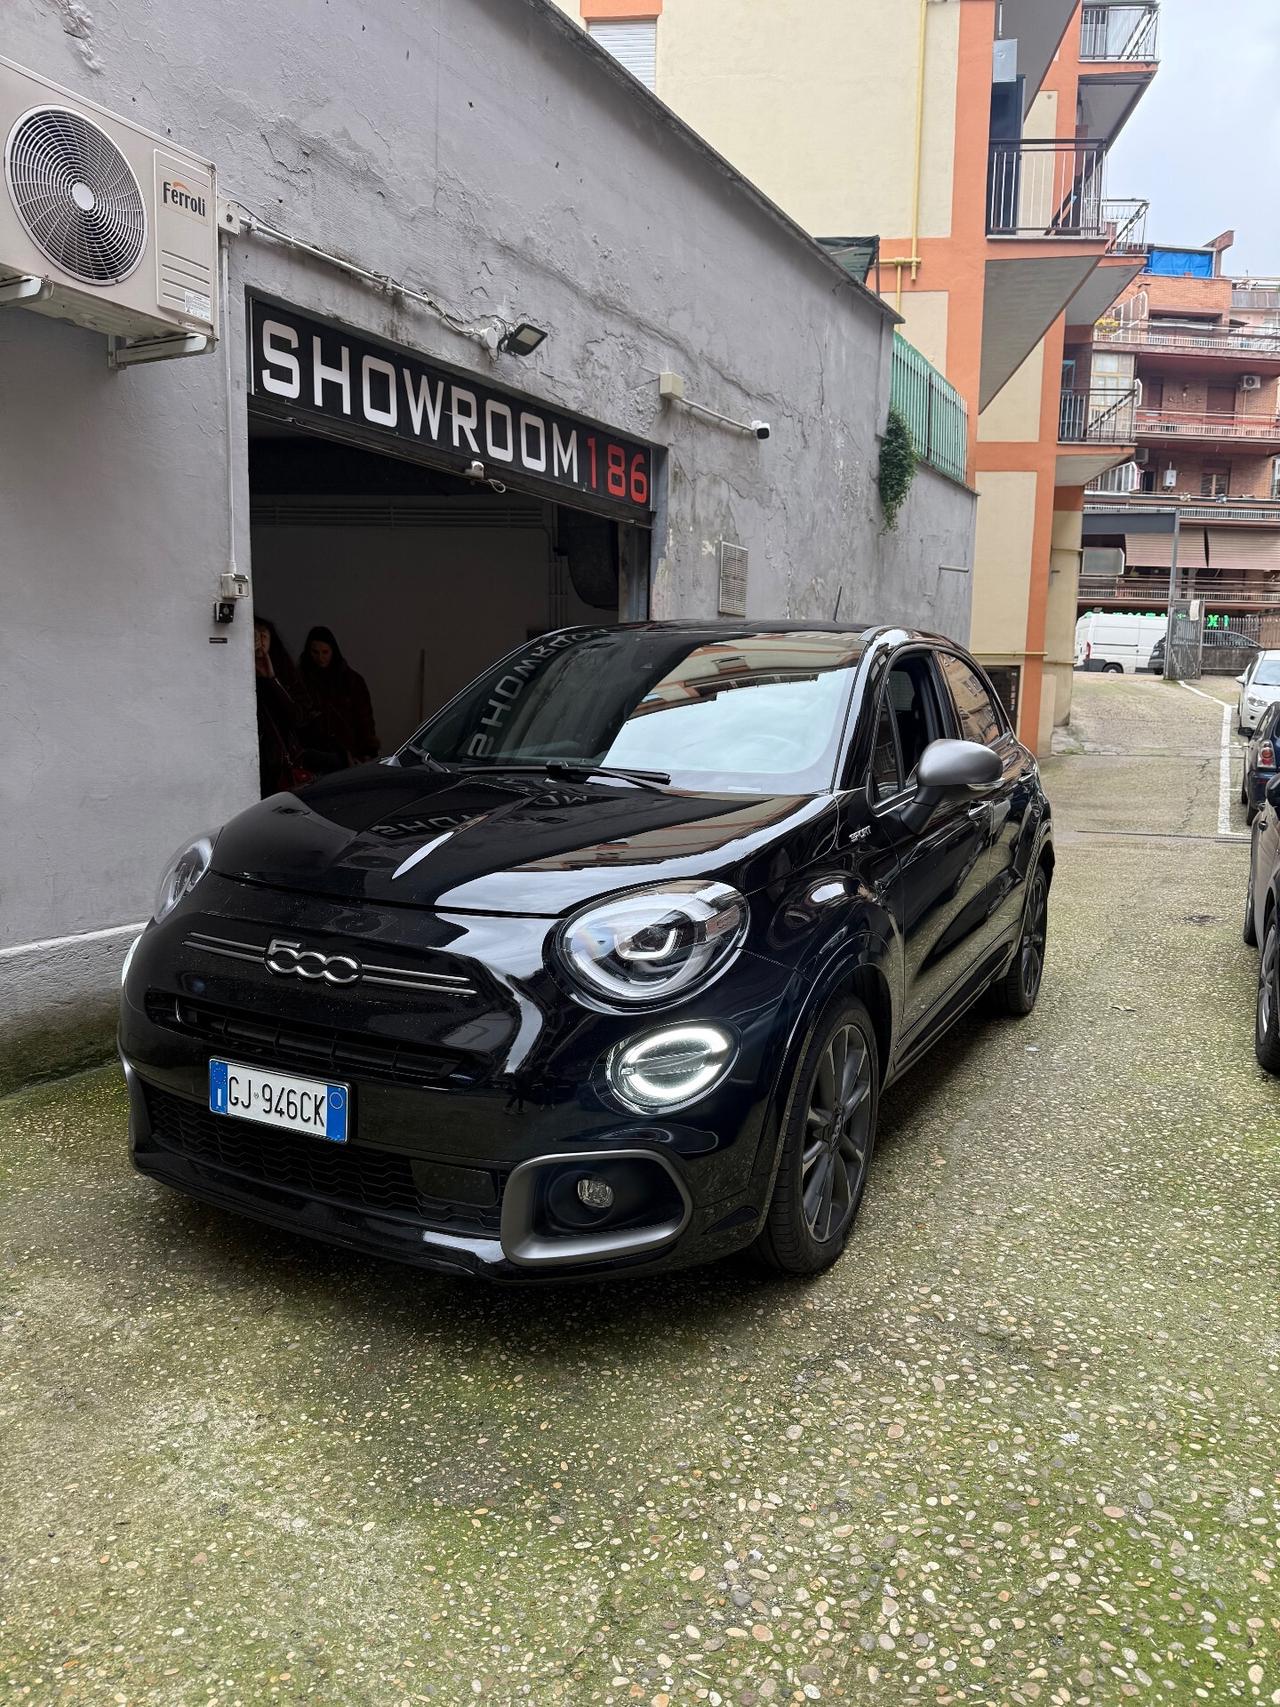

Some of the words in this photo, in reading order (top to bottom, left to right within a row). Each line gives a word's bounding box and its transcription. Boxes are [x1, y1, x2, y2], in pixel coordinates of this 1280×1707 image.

[163, 181, 206, 217] Ferroli
[262, 319, 579, 484] SHOWROOM
[586, 437, 648, 504] 186
[267, 939, 359, 984] 500
